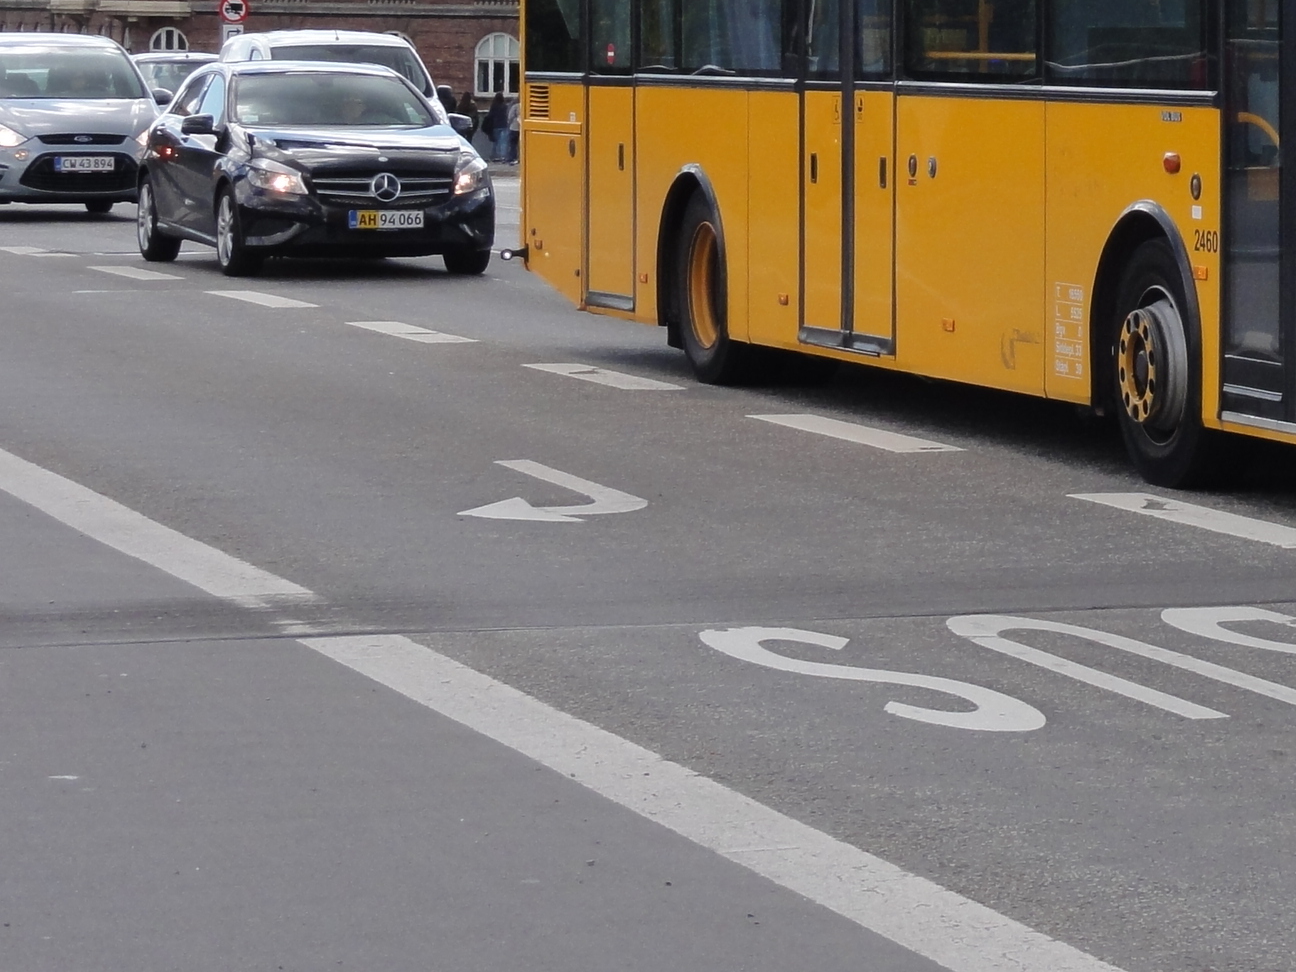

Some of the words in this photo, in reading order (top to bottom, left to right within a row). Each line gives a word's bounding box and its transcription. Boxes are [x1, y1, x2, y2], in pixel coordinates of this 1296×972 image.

[63, 158, 77, 169] CW
[79, 158, 92, 169] 43
[94, 158, 113, 169] 894
[359, 213, 377, 226] AH
[380, 213, 396, 226] 94
[399, 213, 422, 226] 066
[1194, 230, 1219, 253] 2460
